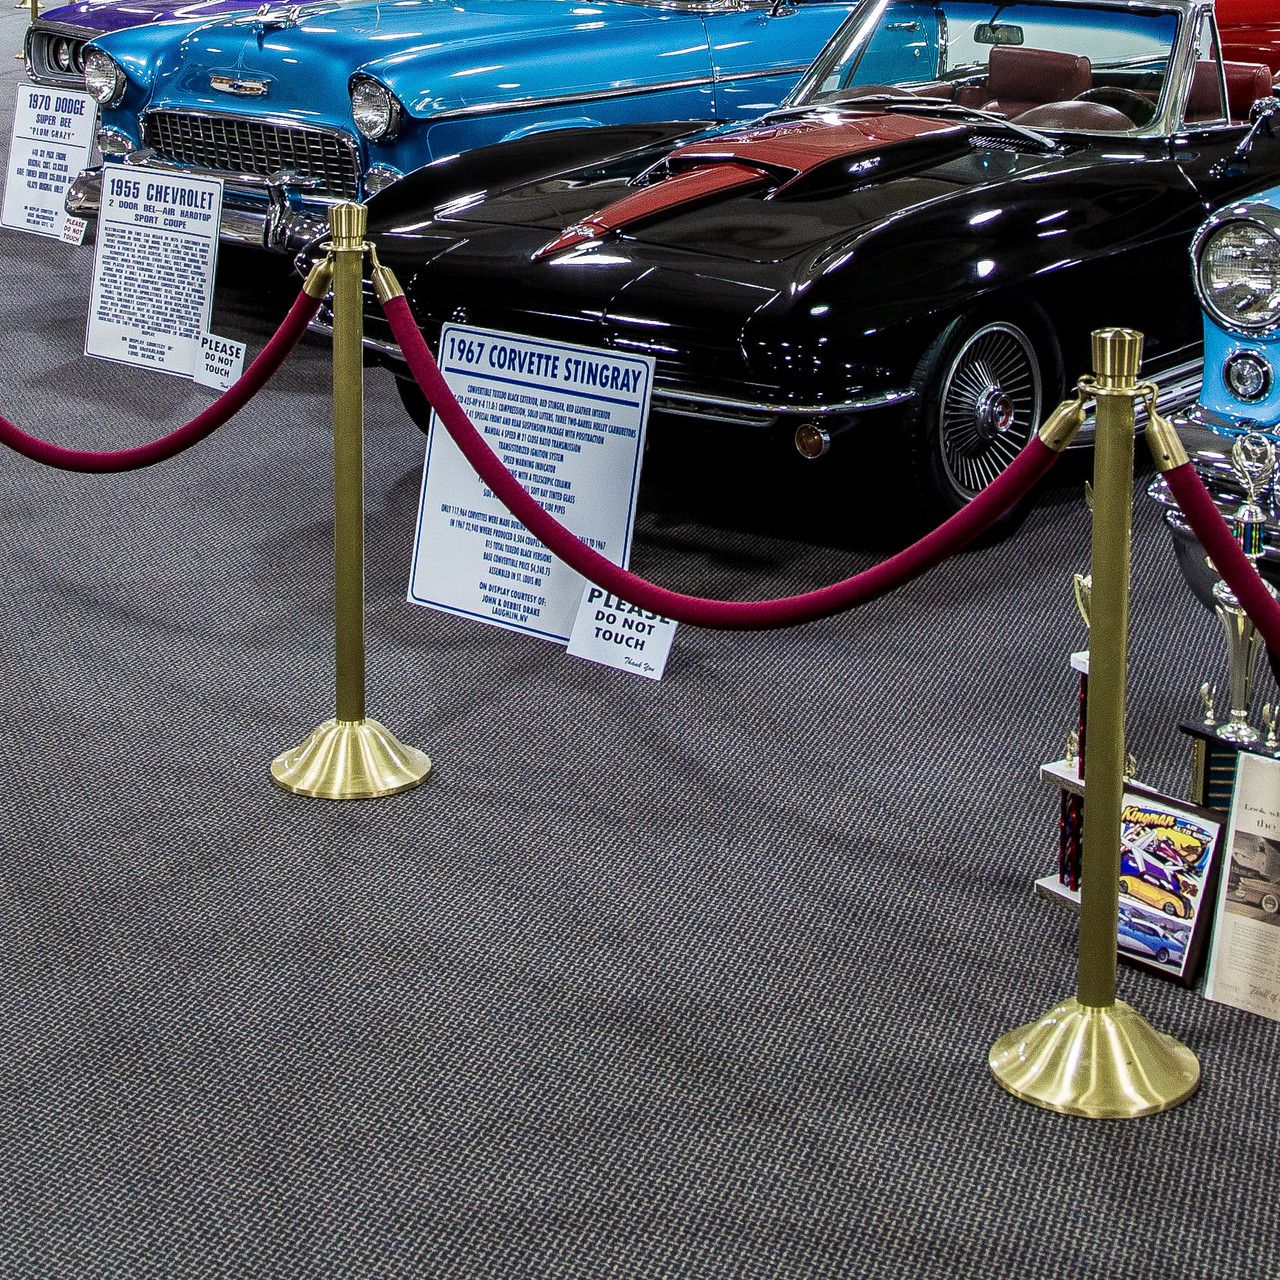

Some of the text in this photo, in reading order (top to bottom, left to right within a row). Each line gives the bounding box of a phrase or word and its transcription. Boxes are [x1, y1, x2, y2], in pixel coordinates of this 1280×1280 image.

[28, 93, 86, 116] 1970 DODGE
[36, 114, 72, 128] SUPER BEE
[110, 178, 214, 210] 1955 CHEVROLET
[108, 198, 114, 208] 2
[118, 200, 138, 211] DOOR
[180, 208, 212, 222] HARDTOP
[67, 217, 85, 228] PLEASE
[72, 228, 83, 236] NOT
[134, 214, 187, 230] SPORT COUPE
[63, 233, 80, 242] TOUCH
[201, 336, 242, 360] PLEASE
[205, 352, 234, 368] DO NOT
[450, 338, 642, 394] 1967 CORVETTE STINGRAY
[205, 363, 230, 378] TOUCH
[467, 384, 492, 397] CONVERTIBLE
[507, 392, 520, 402] BLACK
[592, 408, 610, 420] INTERIOR
[479, 582, 547, 607] ON DISPLAY COURTESY OF:
[482, 594, 496, 606] JOHN
[502, 600, 522, 612] DEBBIE
[522, 604, 540, 617] DRAKE
[588, 587, 670, 625] PLEA
[594, 610, 656, 636] DO NOT
[594, 626, 646, 651] TOUCH
[624, 656, 642, 668] Thank
[1121, 806, 1176, 826] Kingman
[1244, 803, 1266, 814] Look
[1172, 826, 1192, 836] AUTO
[1256, 820, 1276, 832] the
